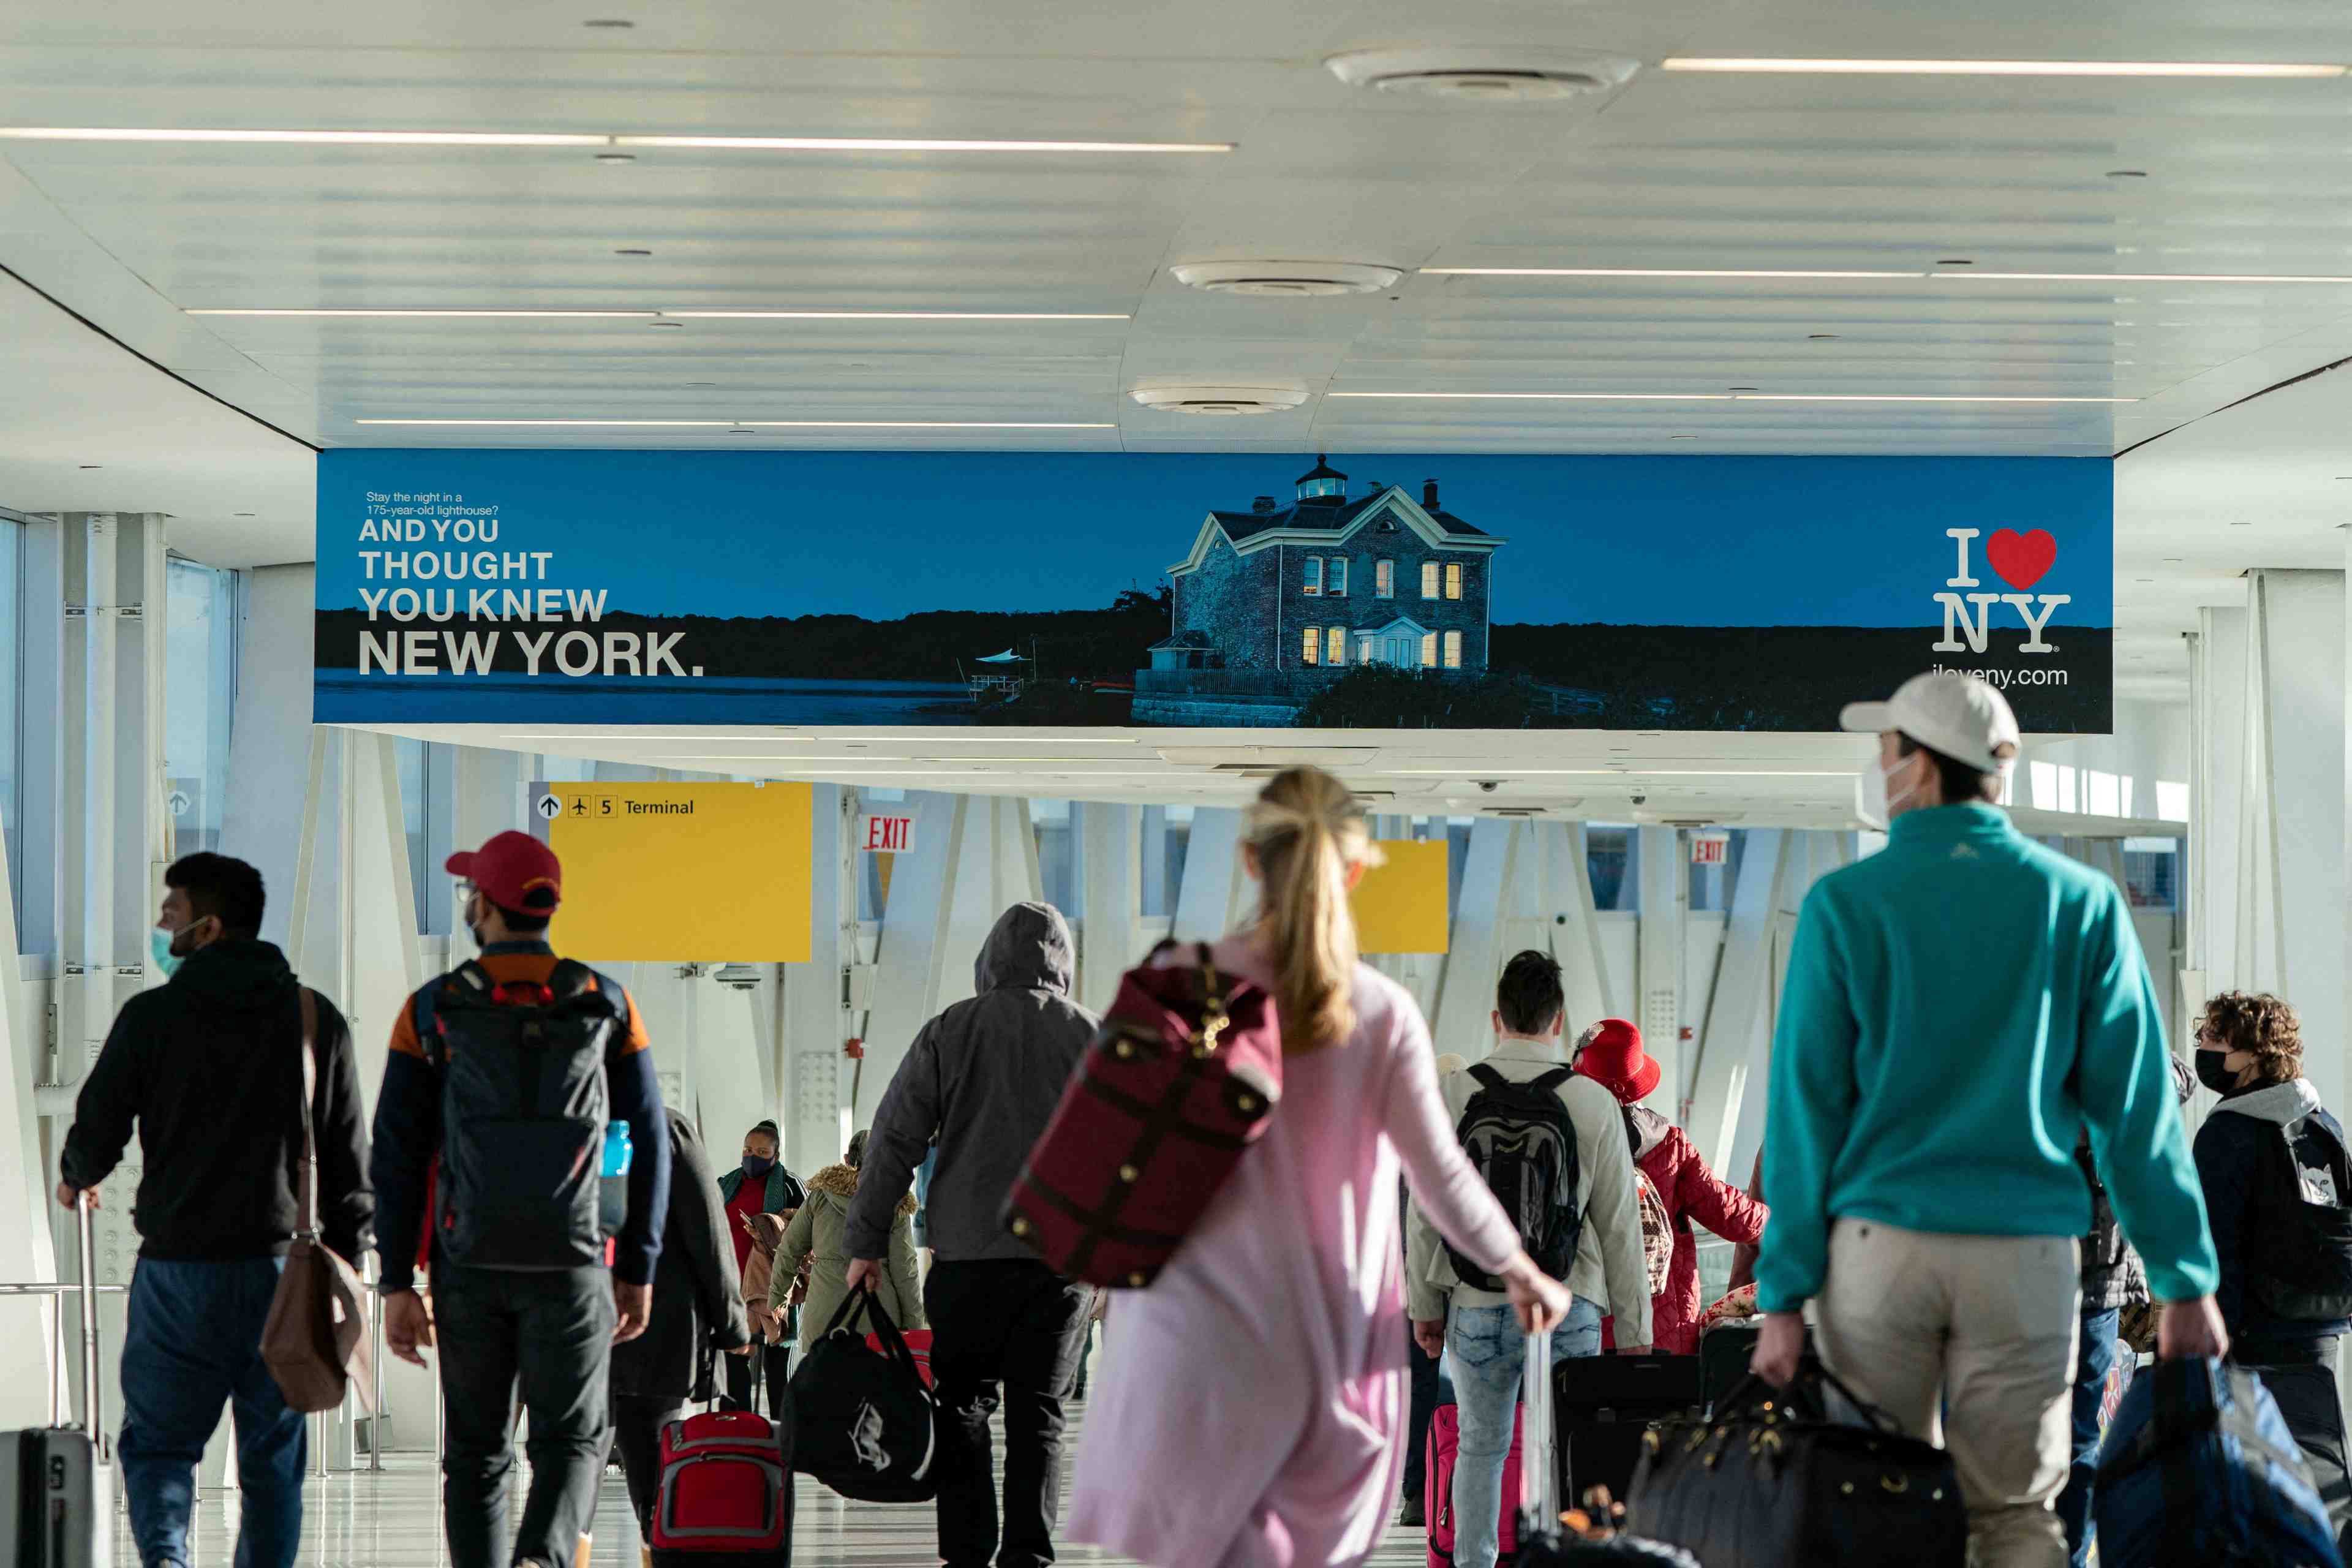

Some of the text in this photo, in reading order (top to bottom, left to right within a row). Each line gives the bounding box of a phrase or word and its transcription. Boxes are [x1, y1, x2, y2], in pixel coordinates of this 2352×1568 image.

[366, 492, 391, 503] Stay
[393, 492, 411, 502] the
[413, 492, 440, 504] night
[443, 492, 453, 502] in
[368, 505, 499, 518] 175-year-old lighthouse?
[358, 519, 498, 543] AND YOU
[359, 551, 552, 579] THOUGHT
[1946, 528, 1980, 587] I
[358, 588, 608, 622] YOU KNEW
[360, 631, 703, 677] NEW YORK.
[601, 800, 694, 815] 5 Terminal
[869, 817, 910, 850] EXIT
[1695, 840, 1723, 862] EXIT
